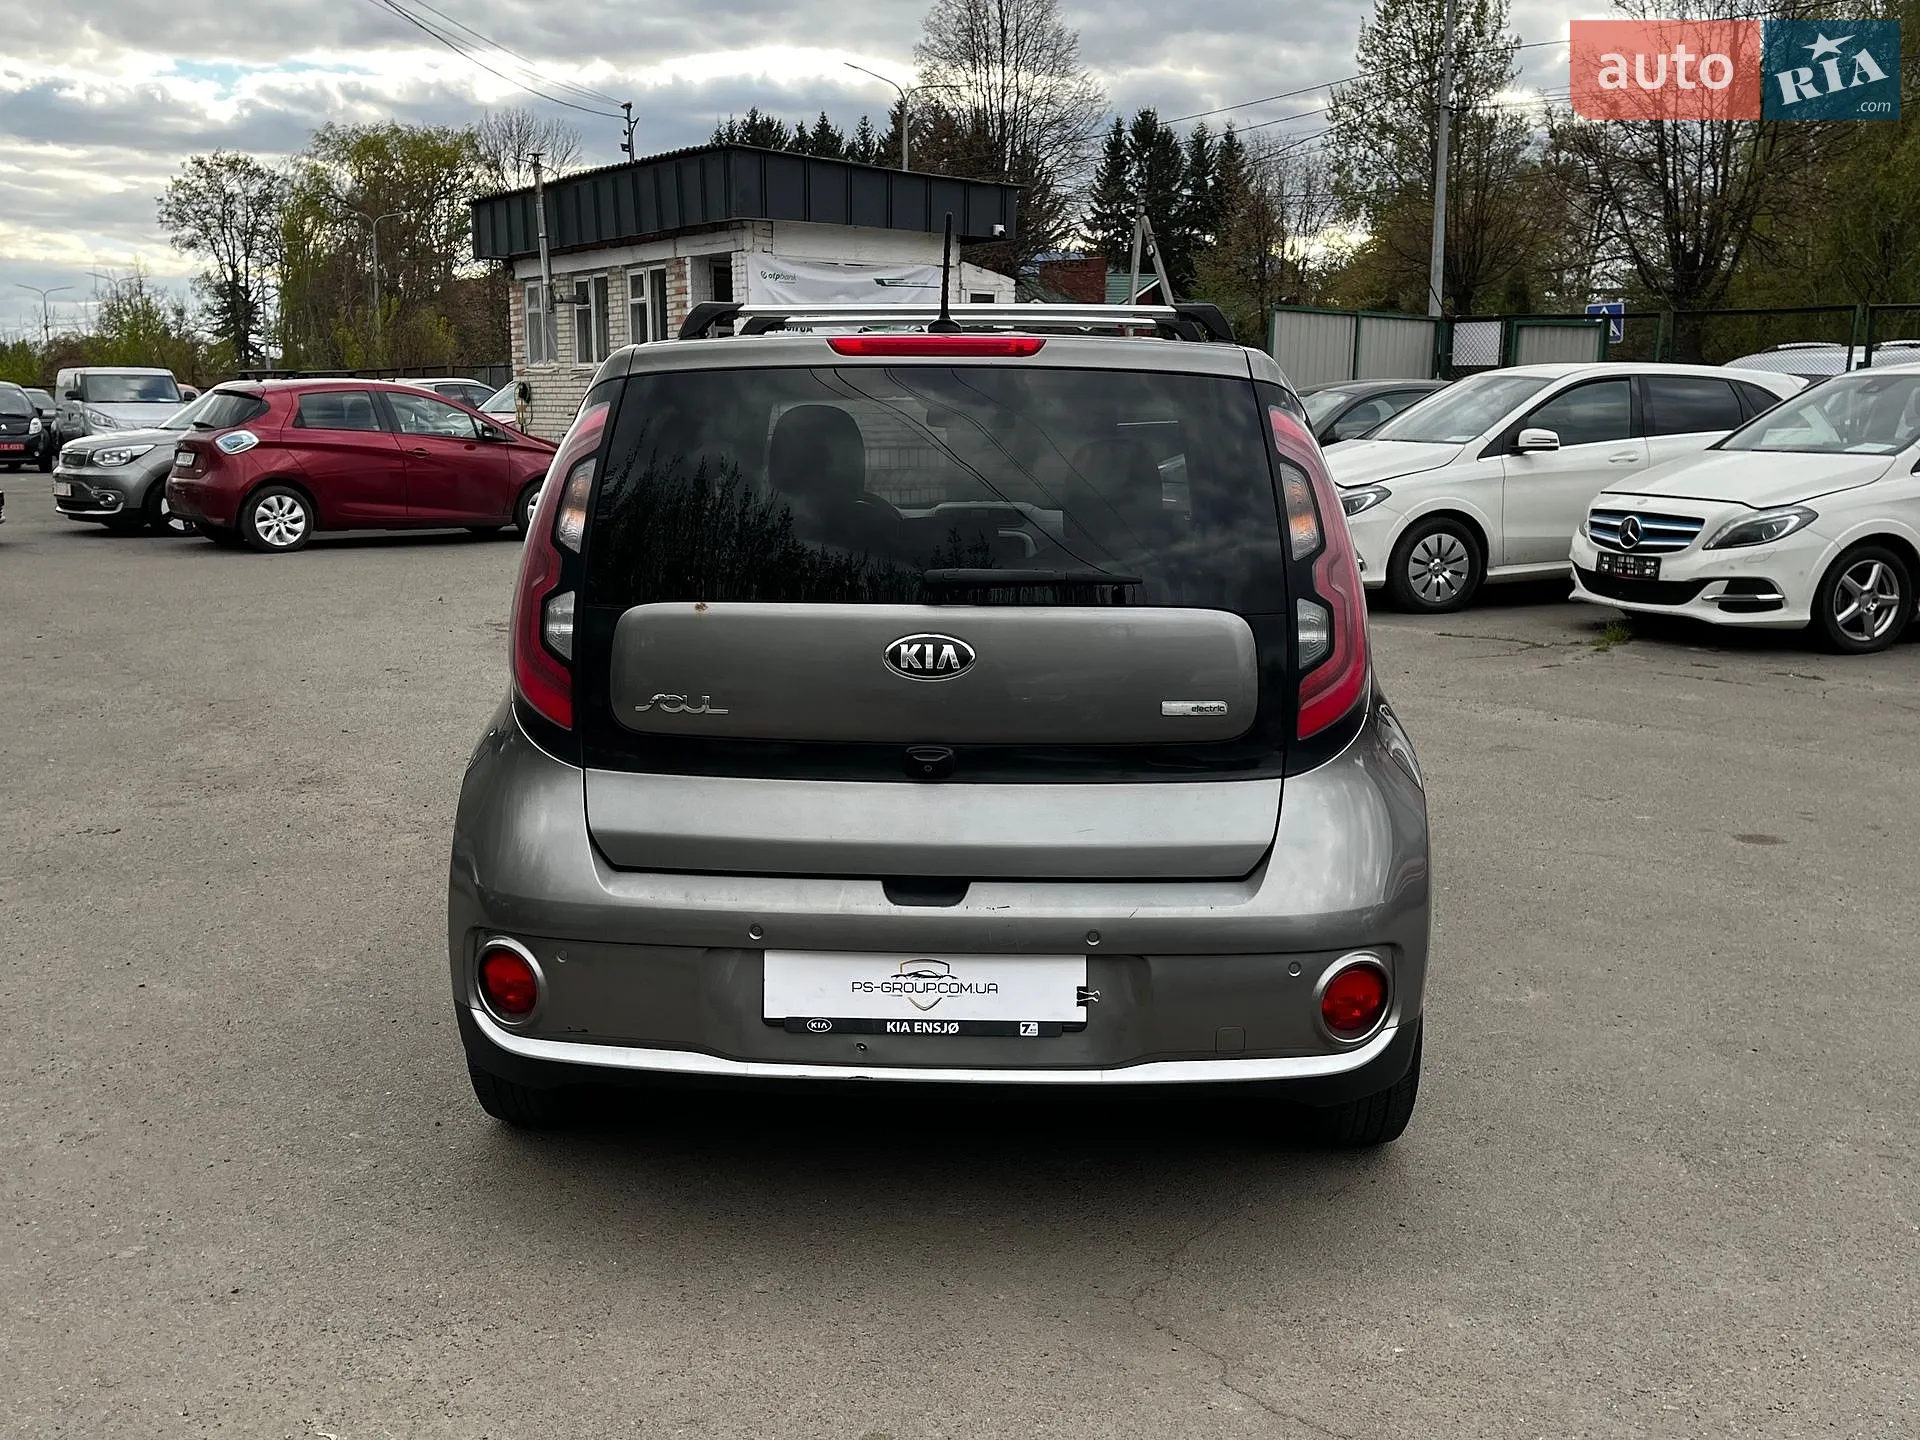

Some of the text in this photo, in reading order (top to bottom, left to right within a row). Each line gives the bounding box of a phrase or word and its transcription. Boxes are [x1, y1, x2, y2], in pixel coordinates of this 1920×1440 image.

[899, 643, 961, 670] KIA
[635, 693, 729, 715] SOUL
[1191, 705, 1225, 713] electric
[851, 980, 999, 995] PS-GROUP.COM.UA
[886, 1021, 960, 1034] KIA ENSJØ
